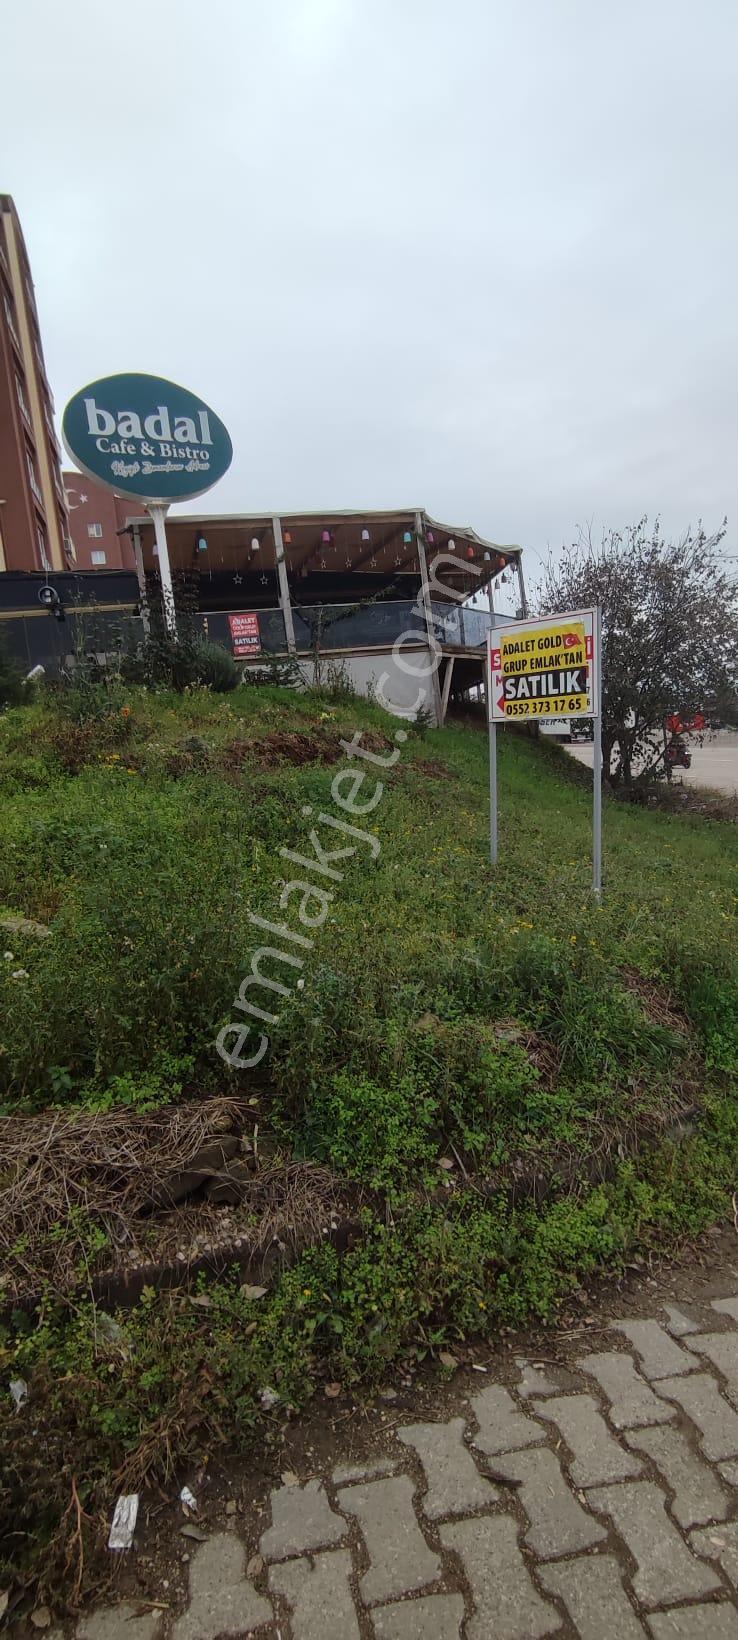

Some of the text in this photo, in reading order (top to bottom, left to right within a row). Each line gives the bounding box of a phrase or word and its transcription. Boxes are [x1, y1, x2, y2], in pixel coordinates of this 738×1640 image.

[83, 398, 213, 445] badal
[95, 437, 210, 460] Cafe & Bistro
[503, 635, 562, 656] ADALET GOLD
[503, 659, 528, 673] GRUP
[530, 651, 583, 669] EMLAK'TAN
[505, 670, 581, 700] SATILIK
[506, 702, 529, 715] 0552
[532, 701, 551, 713] 373
[553, 699, 565, 711] 17
[568, 698, 581, 710] 65
